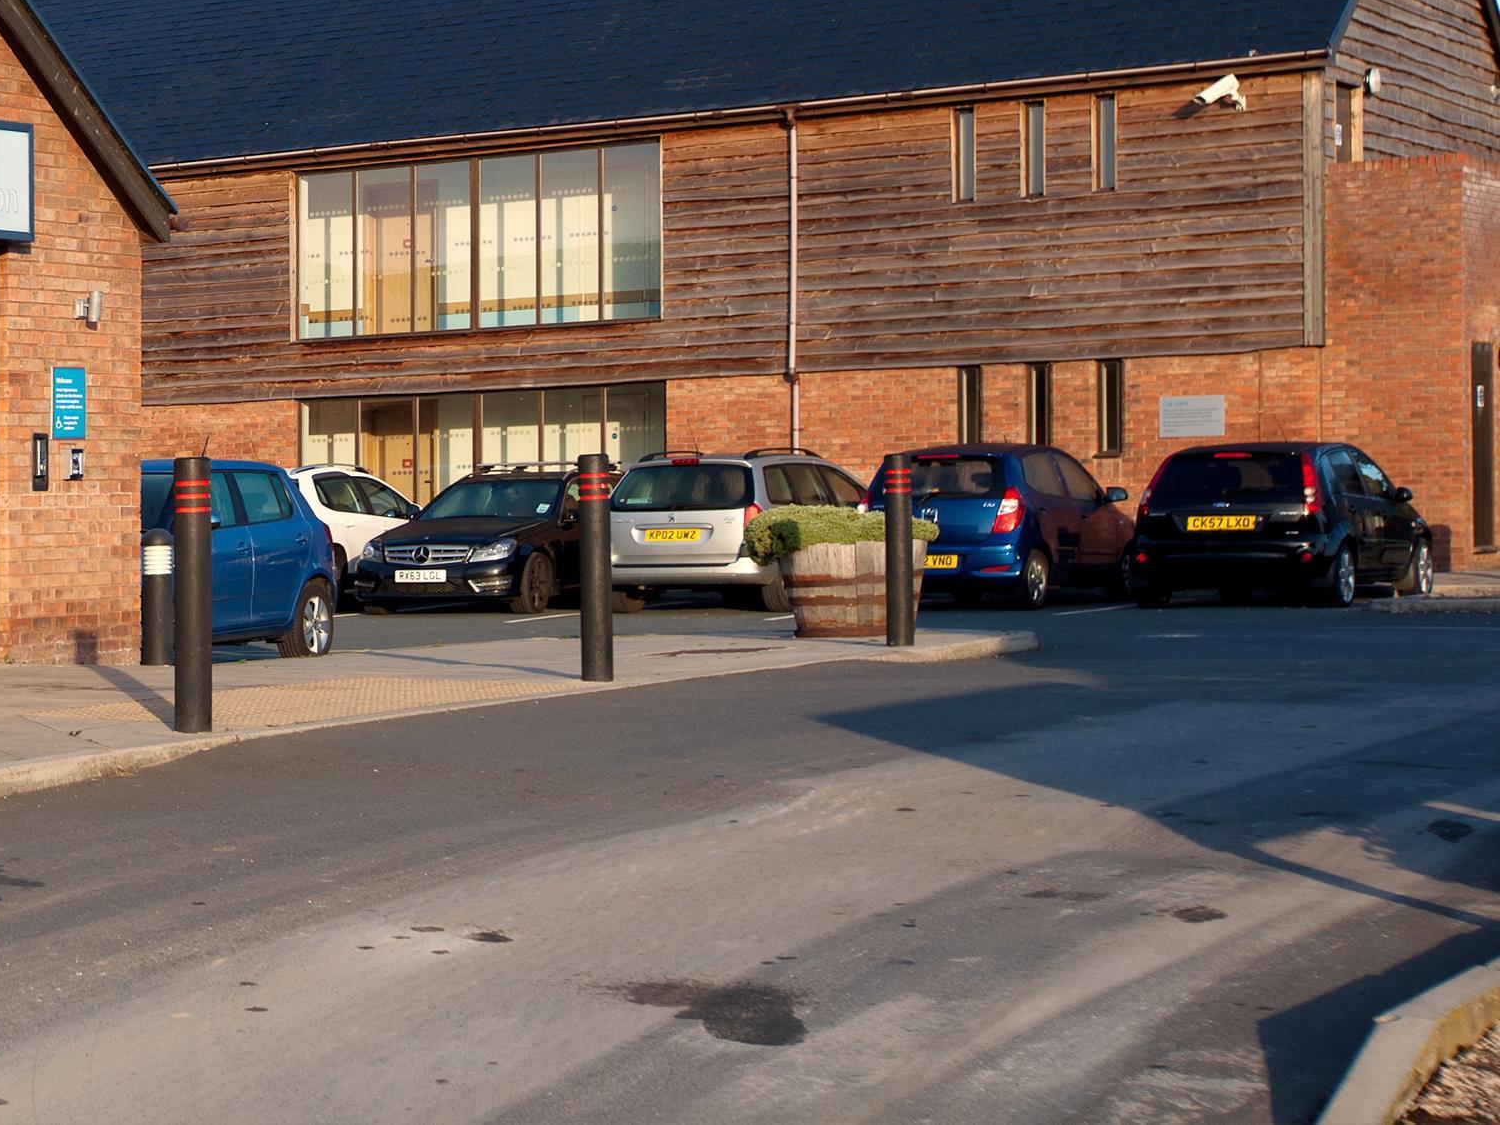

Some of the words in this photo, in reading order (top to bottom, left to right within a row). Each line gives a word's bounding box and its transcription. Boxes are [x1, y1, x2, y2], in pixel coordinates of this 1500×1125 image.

[1192, 517, 1223, 529] CK57
[1226, 517, 1250, 528] LXO
[649, 531, 674, 540] KP02
[676, 530, 697, 540] UWZ
[932, 555, 953, 566] VNO
[399, 571, 421, 580] RX63
[423, 571, 441, 580] LGL
